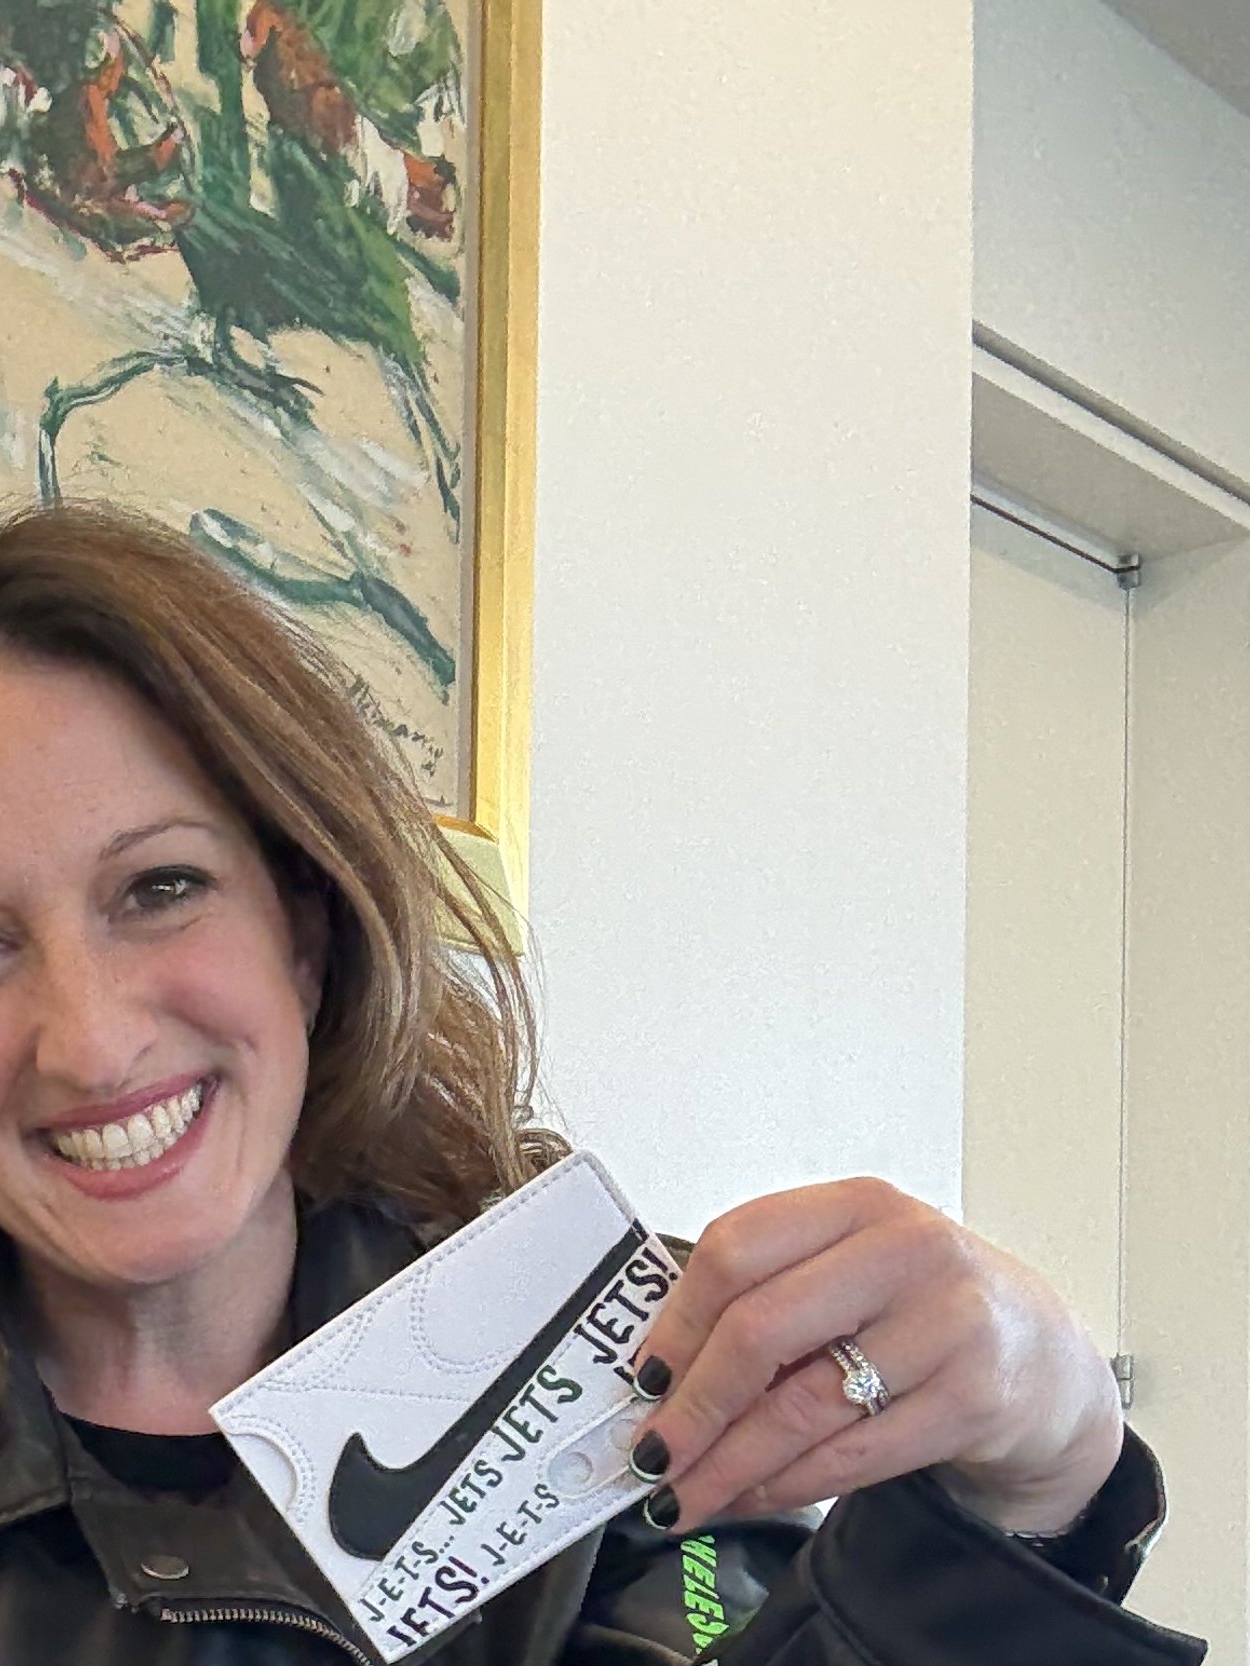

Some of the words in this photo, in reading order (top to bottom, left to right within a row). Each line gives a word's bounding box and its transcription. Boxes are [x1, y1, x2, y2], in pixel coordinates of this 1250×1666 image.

[439, 1459, 503, 1526] JETS
[492, 1364, 583, 1462] JETS
[573, 1246, 679, 1365] JETS!
[481, 1483, 561, 1566] J-E-T-S
